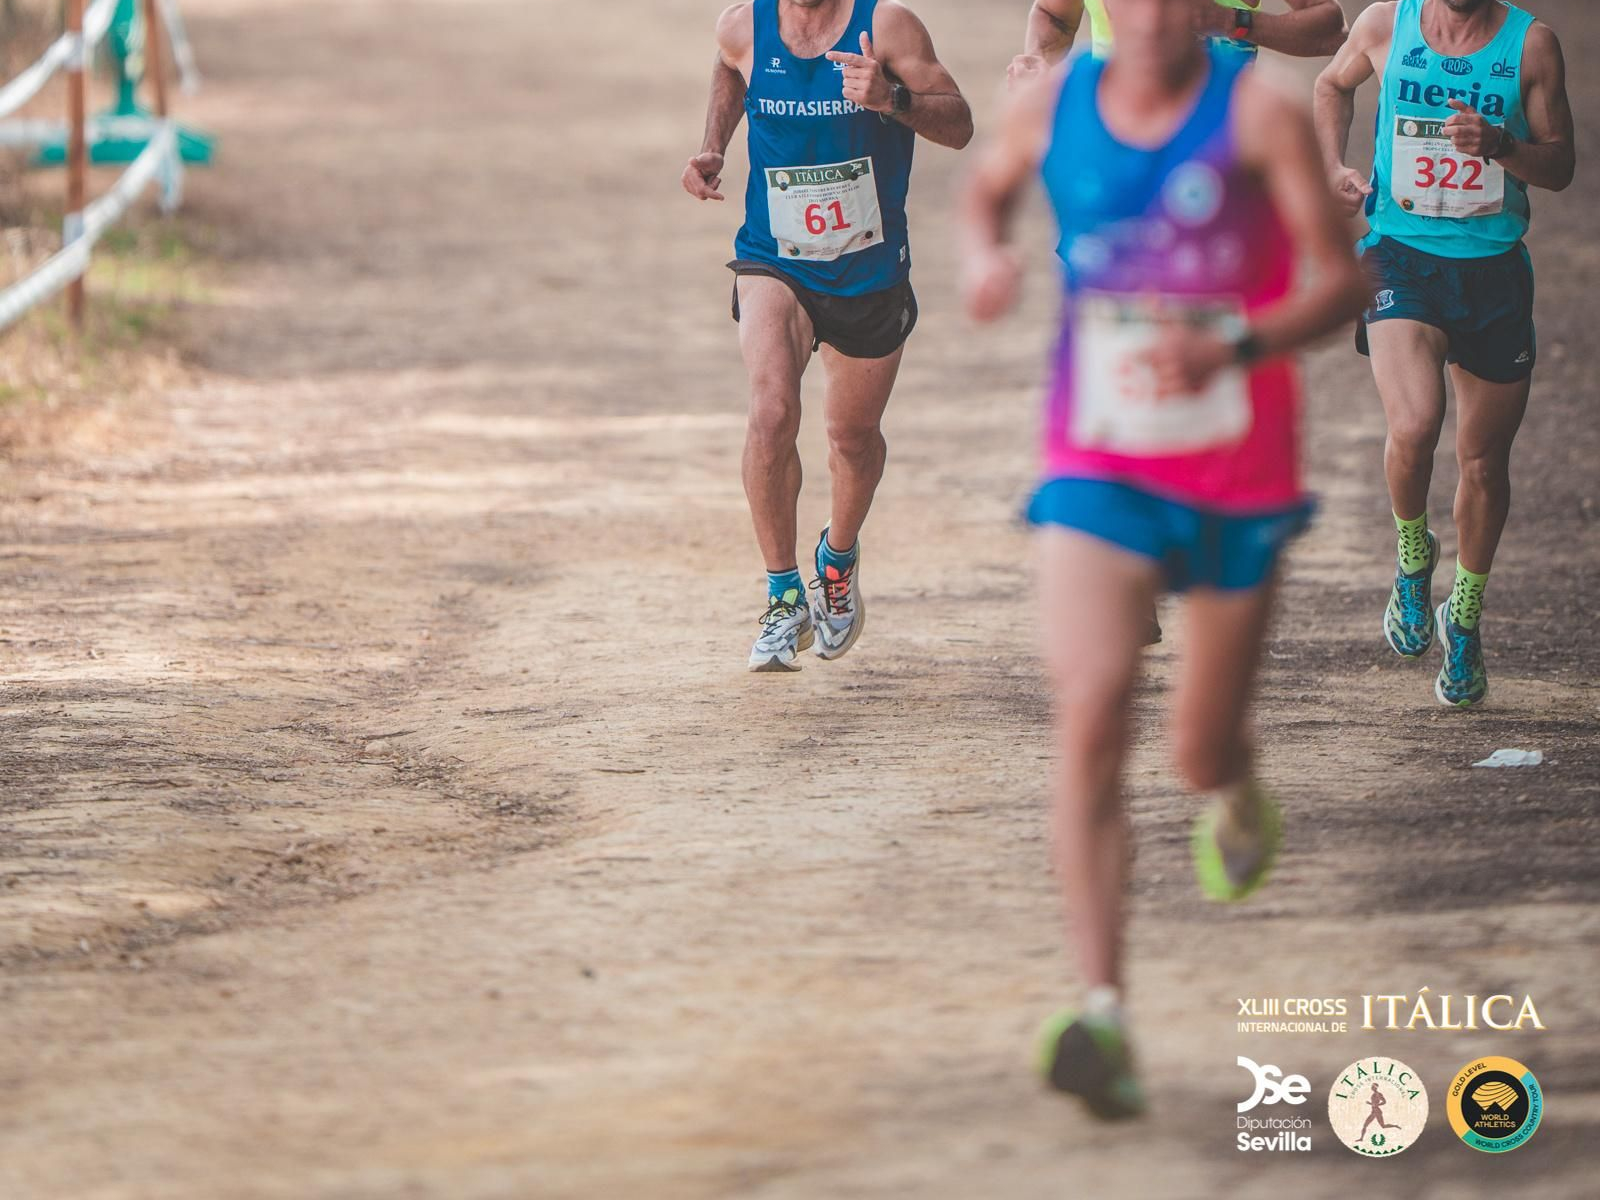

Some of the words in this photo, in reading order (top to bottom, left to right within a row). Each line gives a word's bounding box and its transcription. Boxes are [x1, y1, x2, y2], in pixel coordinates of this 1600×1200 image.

[1442, 59, 1472, 73] TROPS
[758, 98, 865, 116] TROTASIERRA
[795, 169, 844, 183] ITÁLICA
[1415, 156, 1483, 190] 322
[805, 200, 851, 235] 61
